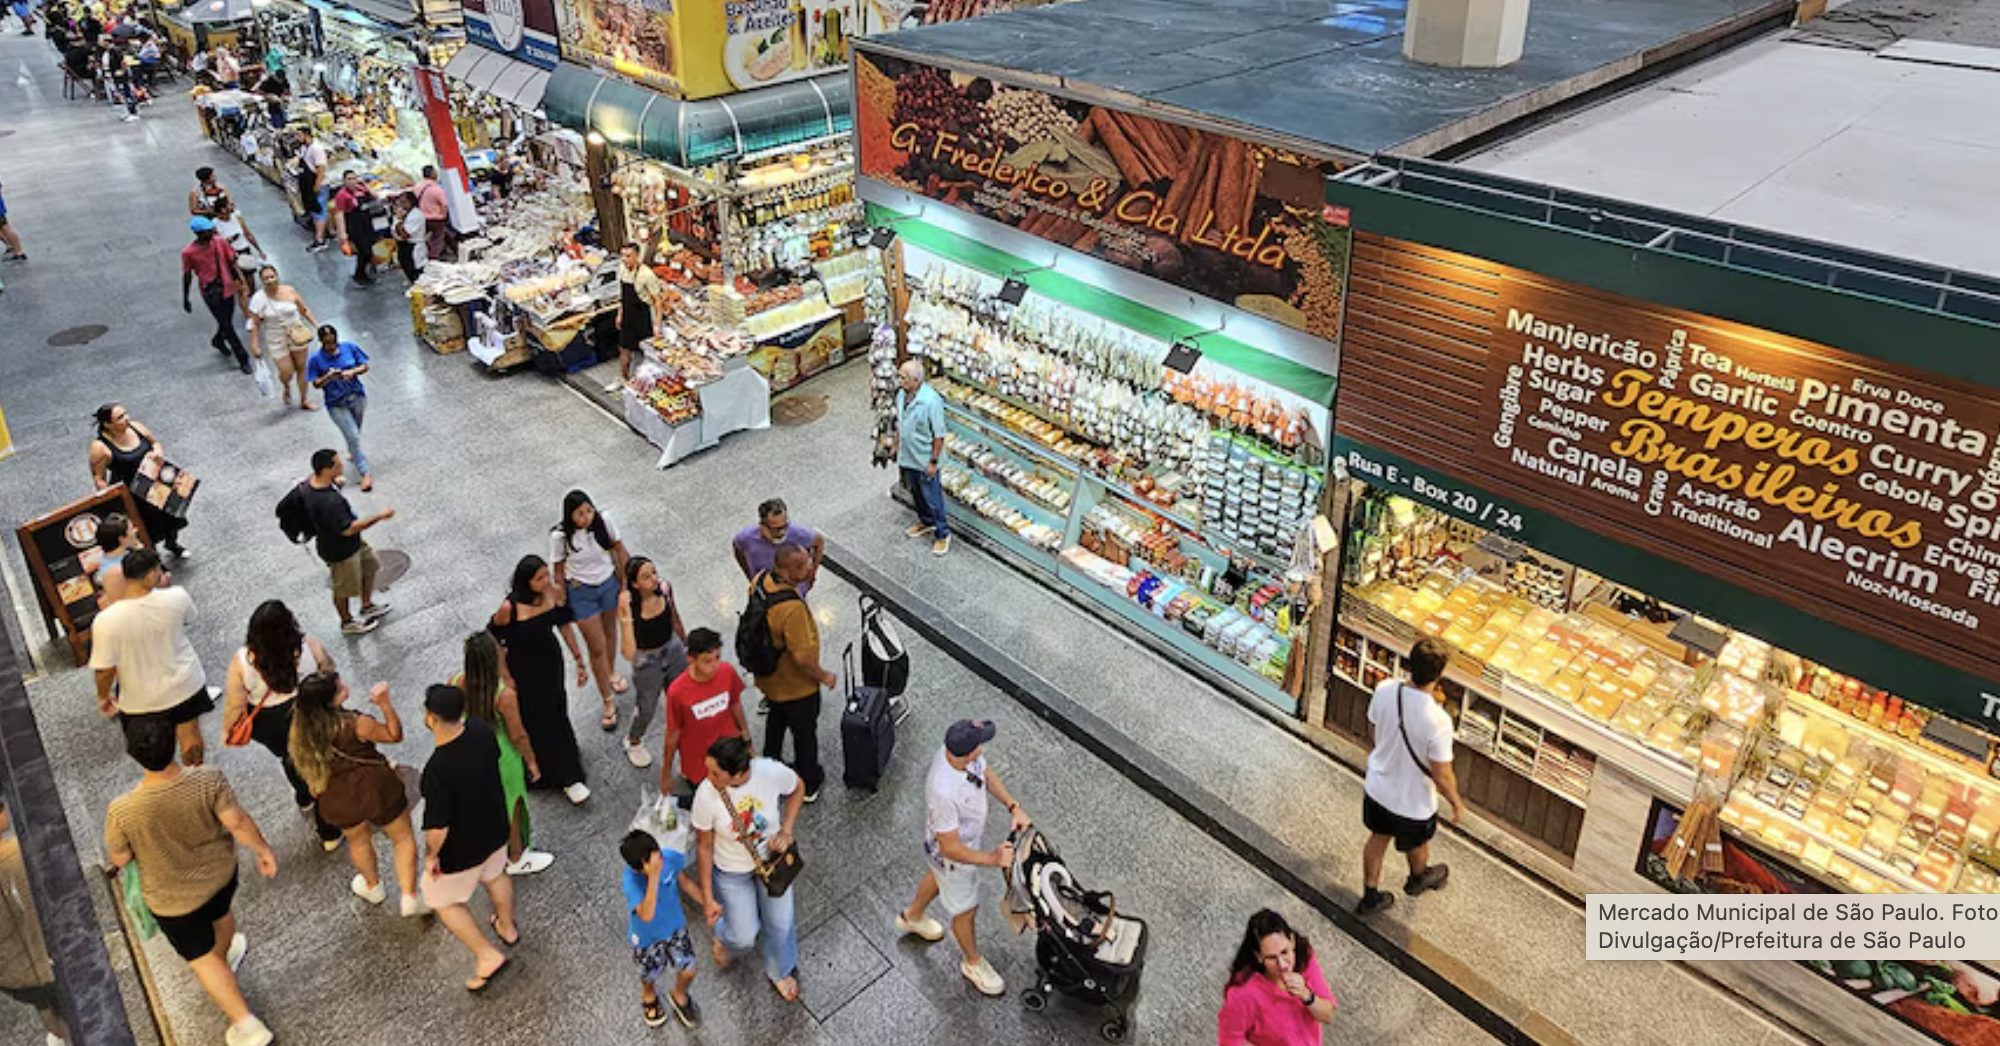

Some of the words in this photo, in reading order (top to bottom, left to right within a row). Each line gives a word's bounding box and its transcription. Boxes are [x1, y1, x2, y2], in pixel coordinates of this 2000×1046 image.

[891, 123, 921, 153] G.
[932, 130, 1068, 198] Frederico
[1078, 178, 1107, 212] &
[1117, 190, 1179, 236] Cia
[1190, 209, 1287, 269] Ltda
[1506, 308, 1657, 368] Manjericão
[1658, 329, 1687, 390] Páprica
[1688, 343, 1733, 374] Tea
[1522, 342, 1606, 386] Herbs
[1528, 368, 1597, 404] Sugar
[1735, 364, 1796, 394] Hortelã
[1492, 364, 1523, 448] Gengibre
[1539, 397, 1611, 433] Pepper
[1689, 373, 1779, 416] Garlic
[1797, 377, 1988, 457] Pimenta
[1852, 378, 1892, 400] Erva
[1895, 390, 1945, 415] Doce
[1527, 415, 1583, 441] Cominho
[1602, 368, 1859, 476] Temperos
[1789, 409, 1873, 443] Coentro
[1511, 447, 1586, 487] Natural
[1547, 437, 1643, 487] Canela
[1610, 418, 1922, 548] Brasileiros
[1869, 443, 1974, 497] Curry
[1349, 451, 1383, 478] Rua
[1386, 465, 1400, 484] E
[1412, 475, 1449, 503] Box
[1452, 491, 1478, 513] 20
[1480, 502, 1494, 521] /
[1496, 509, 1523, 532] 24
[1590, 477, 1640, 502] Aroma
[1643, 469, 1669, 516] Cravo
[1677, 482, 1761, 521] Açafrão
[1858, 472, 1944, 514] Cebola
[1670, 500, 1775, 549] Traditional
[1778, 518, 1939, 594] Alecrim
[1923, 544, 2000, 585] Ervas
[1846, 570, 1979, 630] Noz-Moscada
